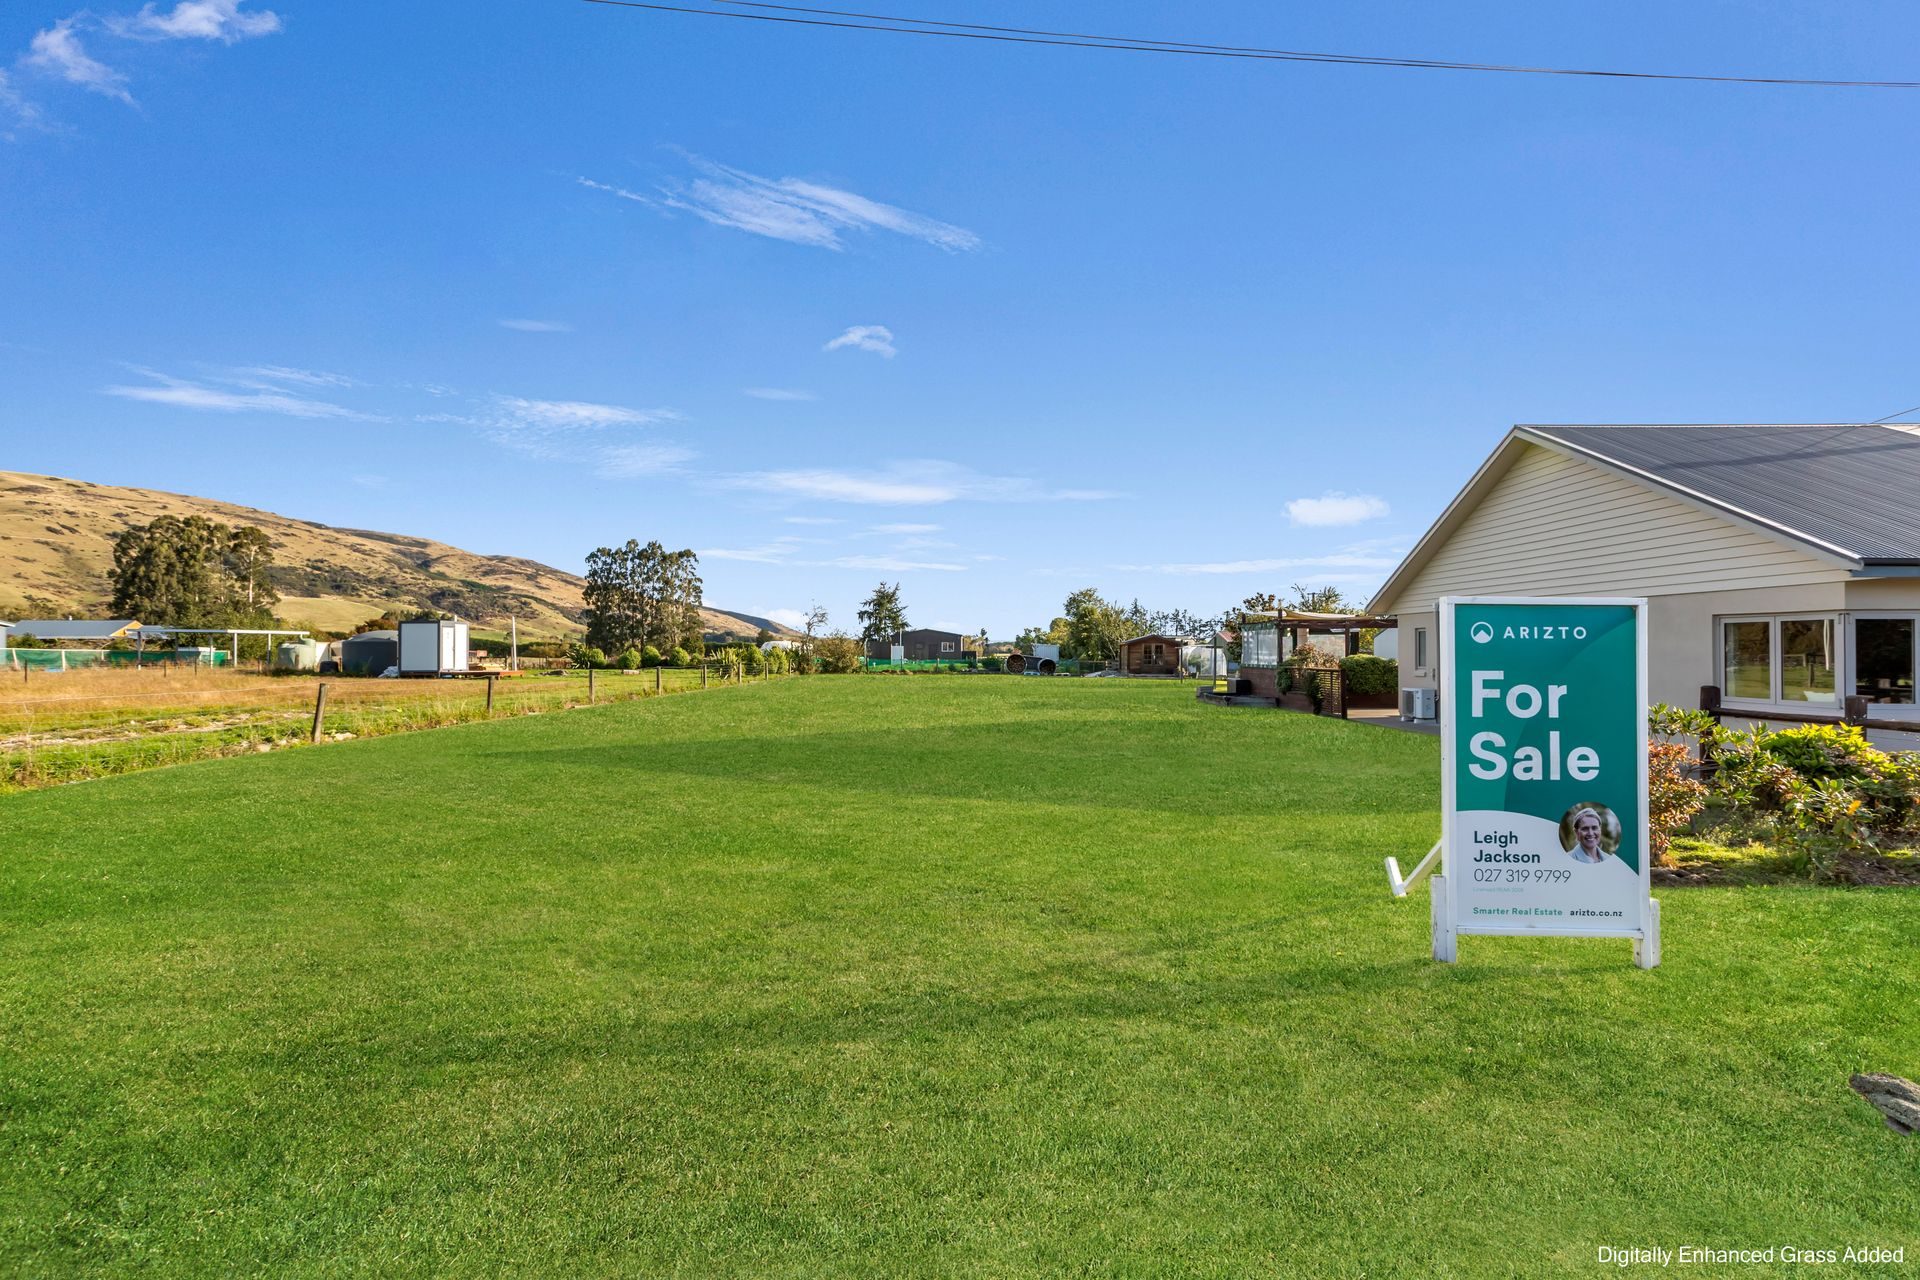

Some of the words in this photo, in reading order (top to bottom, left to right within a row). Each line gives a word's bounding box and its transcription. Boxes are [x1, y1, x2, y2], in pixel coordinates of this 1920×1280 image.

[1504, 626, 1587, 639] ARIZTO
[1471, 670, 1568, 718] For
[1469, 731, 1600, 781] Sale
[1474, 830, 1518, 848] Leigh
[1474, 849, 1541, 864] Jackson
[1474, 868, 1502, 882] 027
[1506, 869, 1530, 882] 319
[1534, 869, 1572, 883] 9799
[1473, 906, 1509, 915] Smarter
[1512, 907, 1532, 915] Real
[1534, 908, 1563, 916] Estate
[1570, 908, 1623, 917] arizto.co.nz
